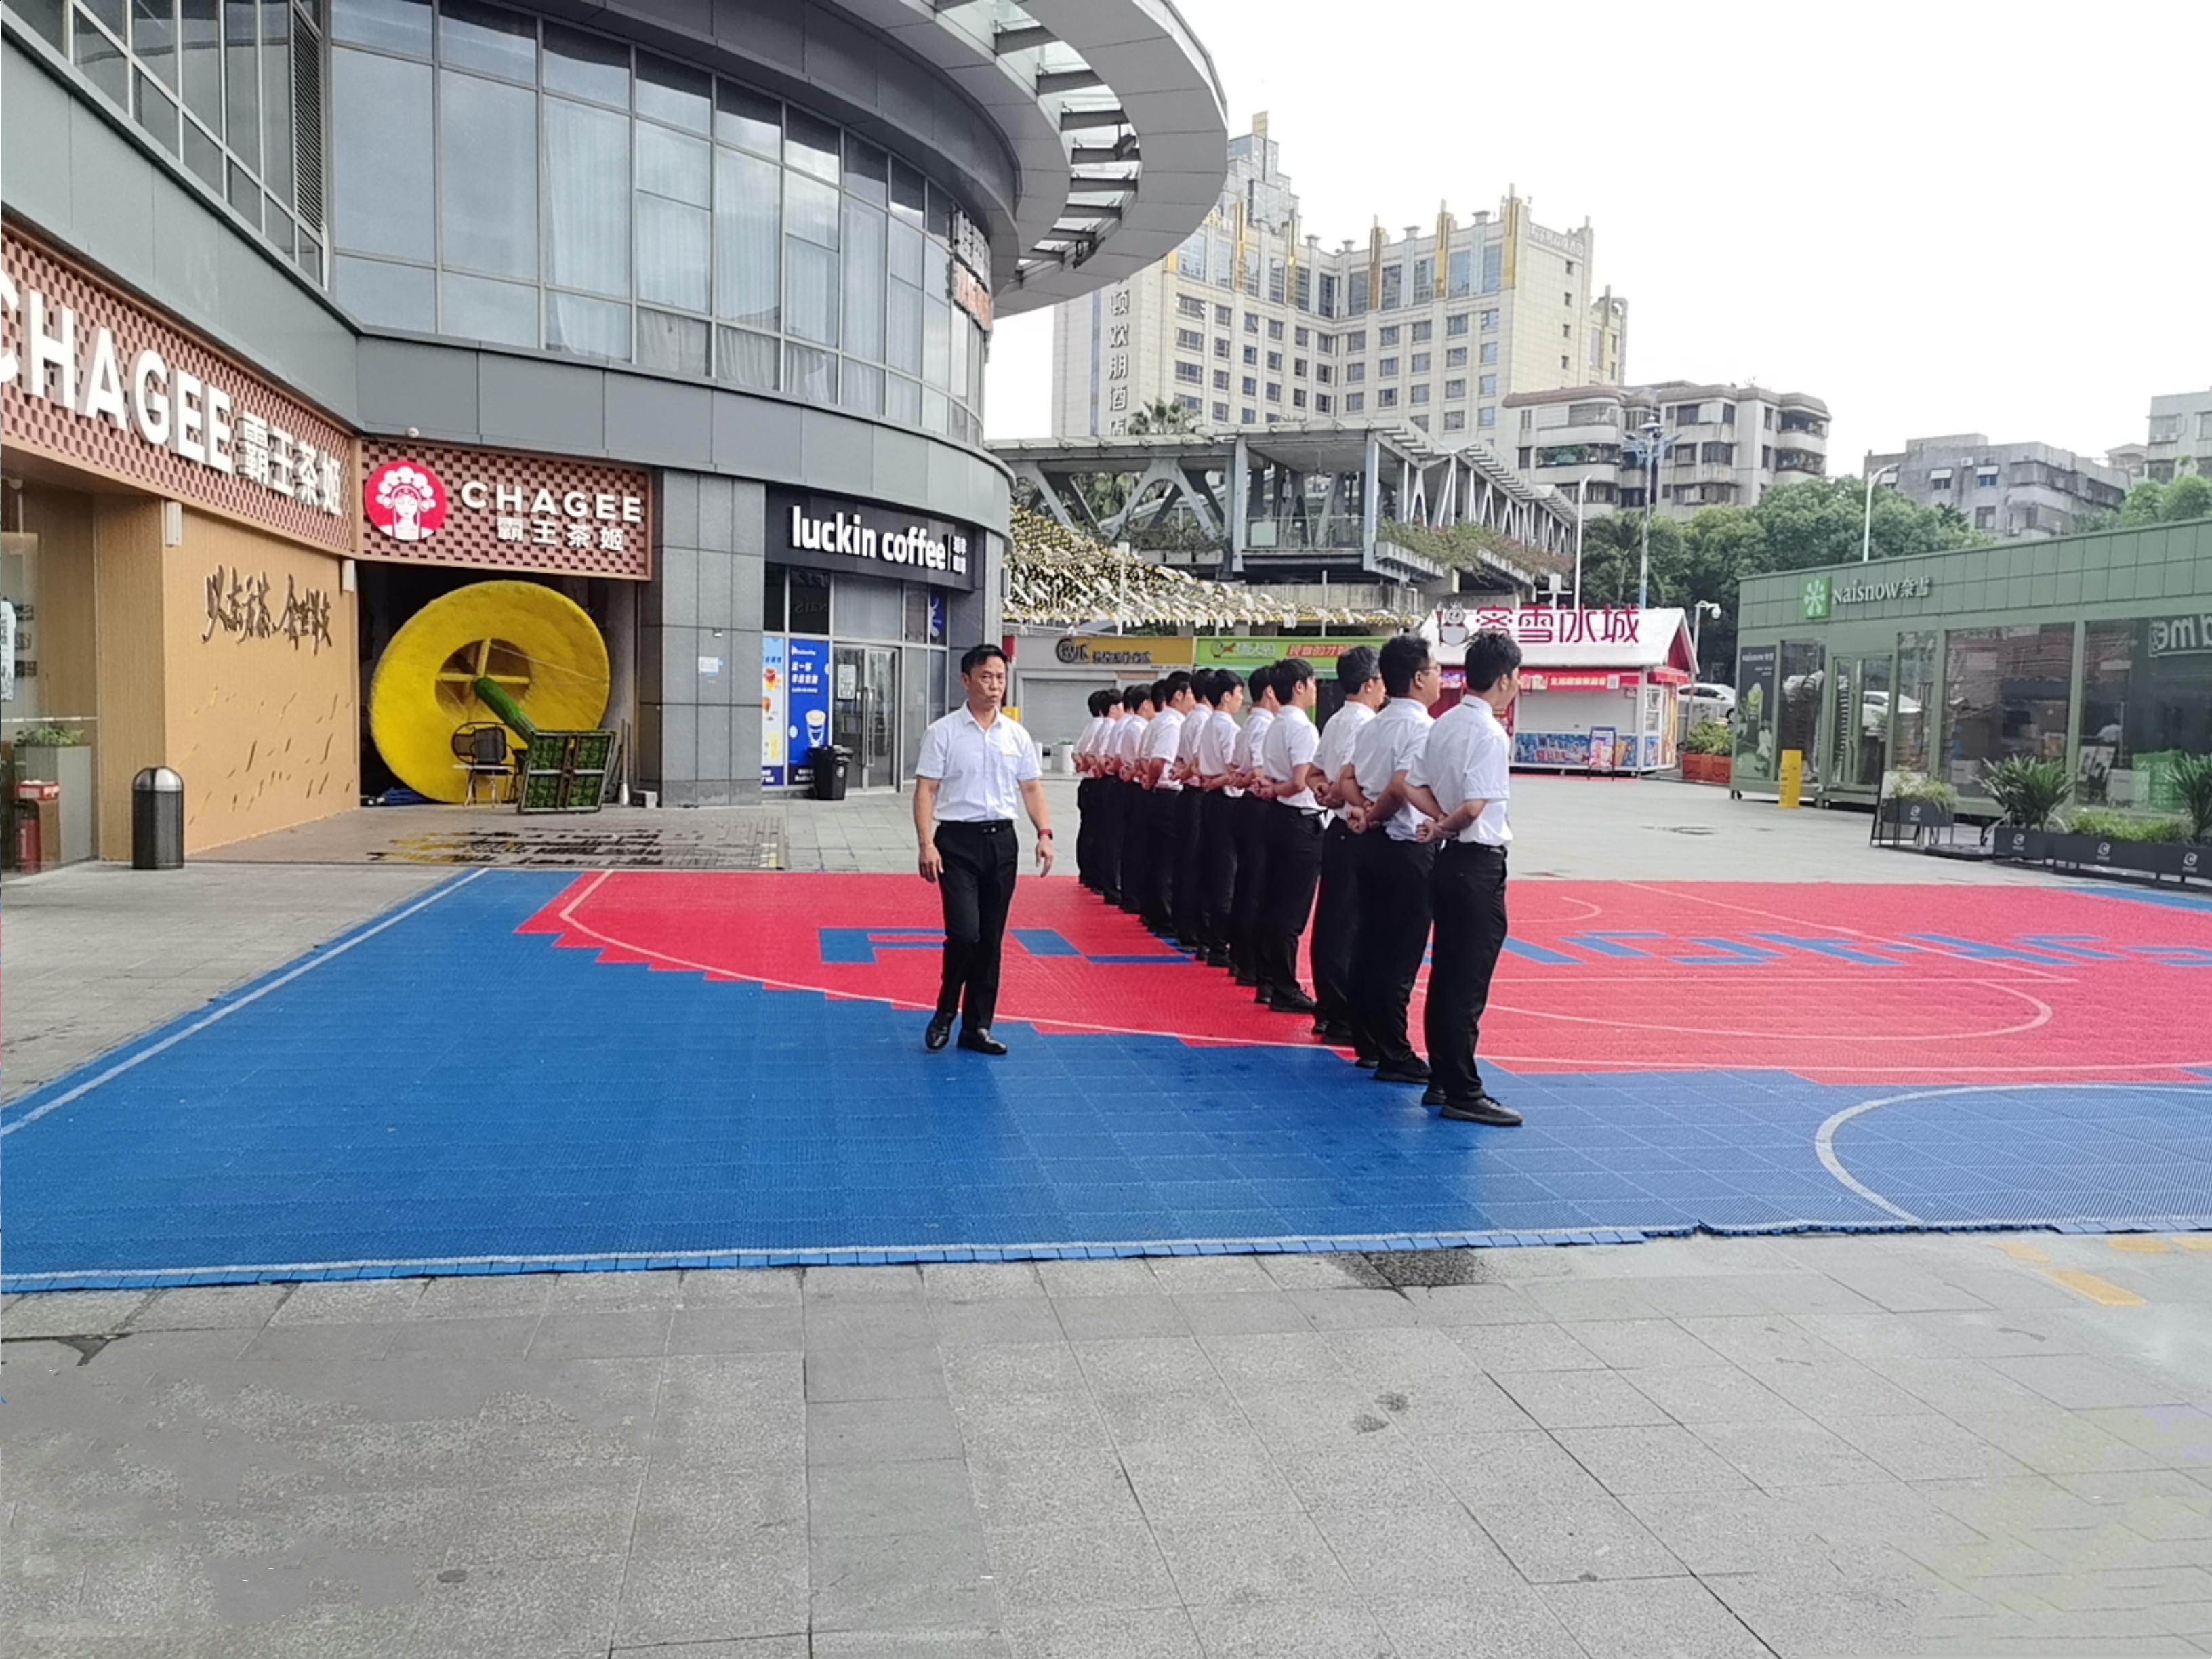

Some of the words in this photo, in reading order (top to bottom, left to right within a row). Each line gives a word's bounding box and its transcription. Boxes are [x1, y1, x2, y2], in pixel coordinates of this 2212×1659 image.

[243, 411, 343, 517] 霸王茶姬
[461, 480, 642, 523] CHAGEE
[496, 517, 625, 552] 霸王茶姬
[792, 505, 876, 558] luckin
[882, 526, 946, 571] coffee
[1832, 579, 1899, 605] Naisnow
[1475, 603, 1640, 643] 蜜雪冰城
